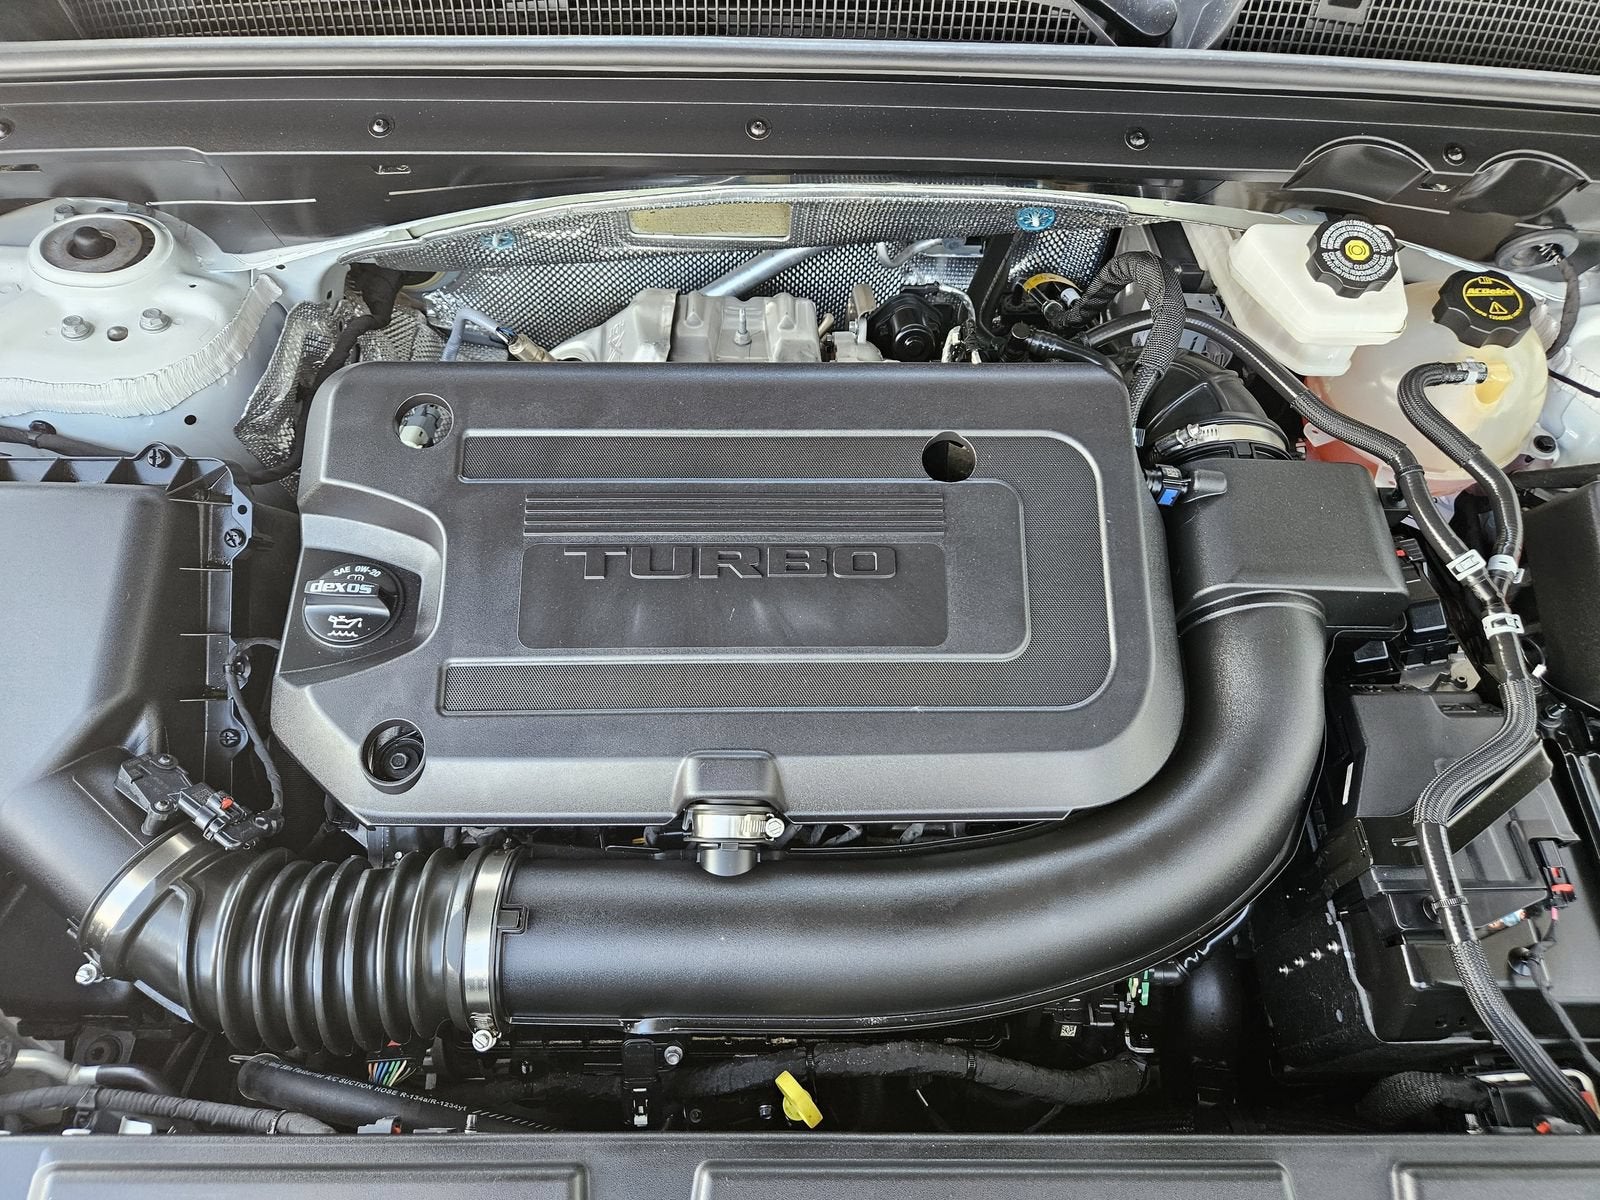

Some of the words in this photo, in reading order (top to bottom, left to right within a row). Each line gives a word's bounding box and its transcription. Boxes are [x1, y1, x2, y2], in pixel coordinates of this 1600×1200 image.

[333, 566, 351, 576] SAE
[354, 565, 382, 578] 0W-20
[564, 547, 897, 579] TURBO
[309, 579, 375, 594] dexos
[338, 1077, 374, 1090] SUCTION
[374, 1086, 399, 1096] HOSE
